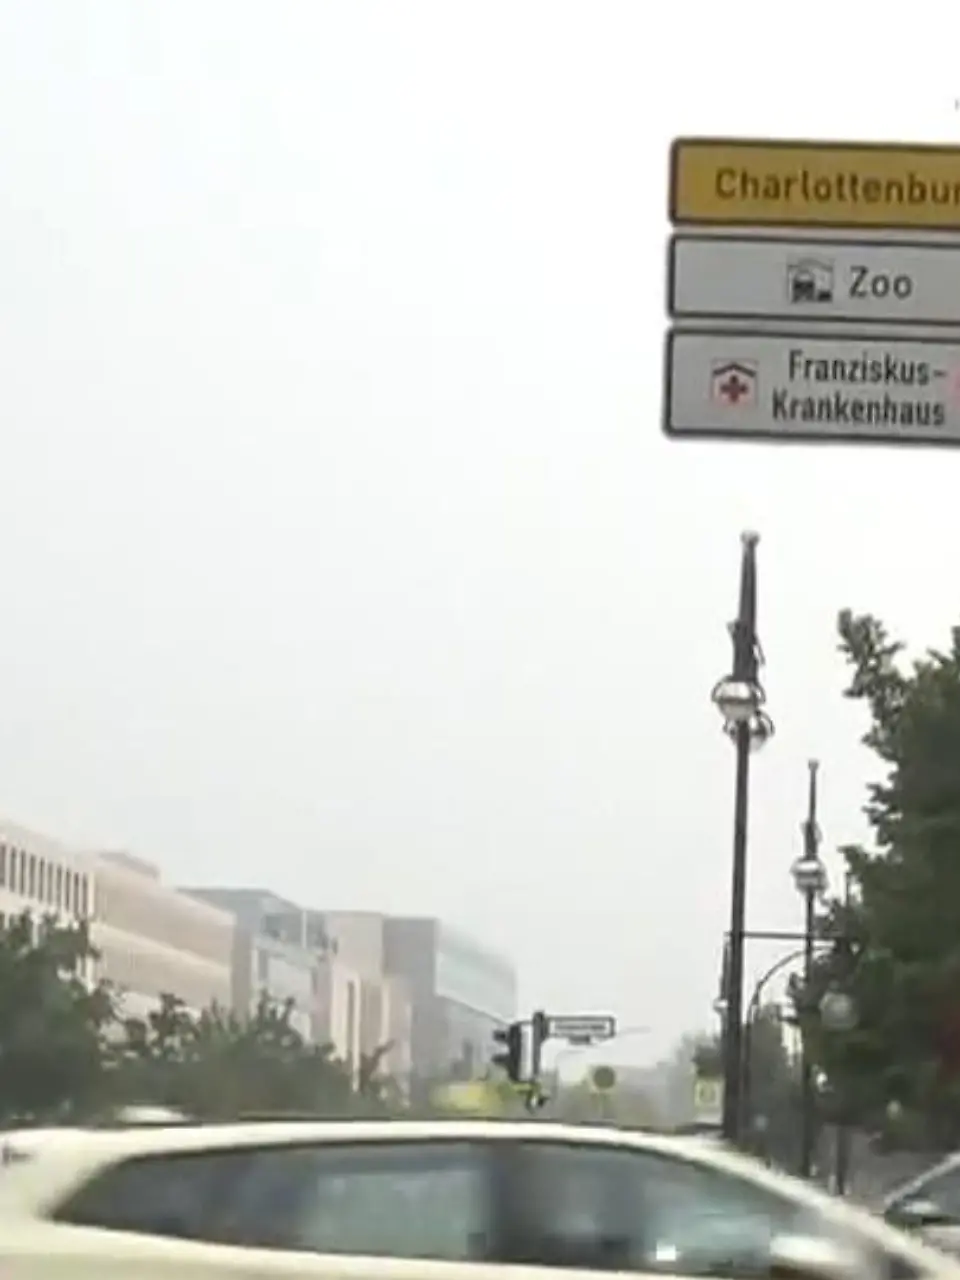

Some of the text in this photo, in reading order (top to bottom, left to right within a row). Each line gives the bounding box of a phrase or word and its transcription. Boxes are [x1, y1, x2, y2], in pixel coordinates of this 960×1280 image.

[848, 266, 913, 299] Zoo
[788, 350, 948, 384] Franziskus-
[771, 392, 946, 426] Krankenhaus
